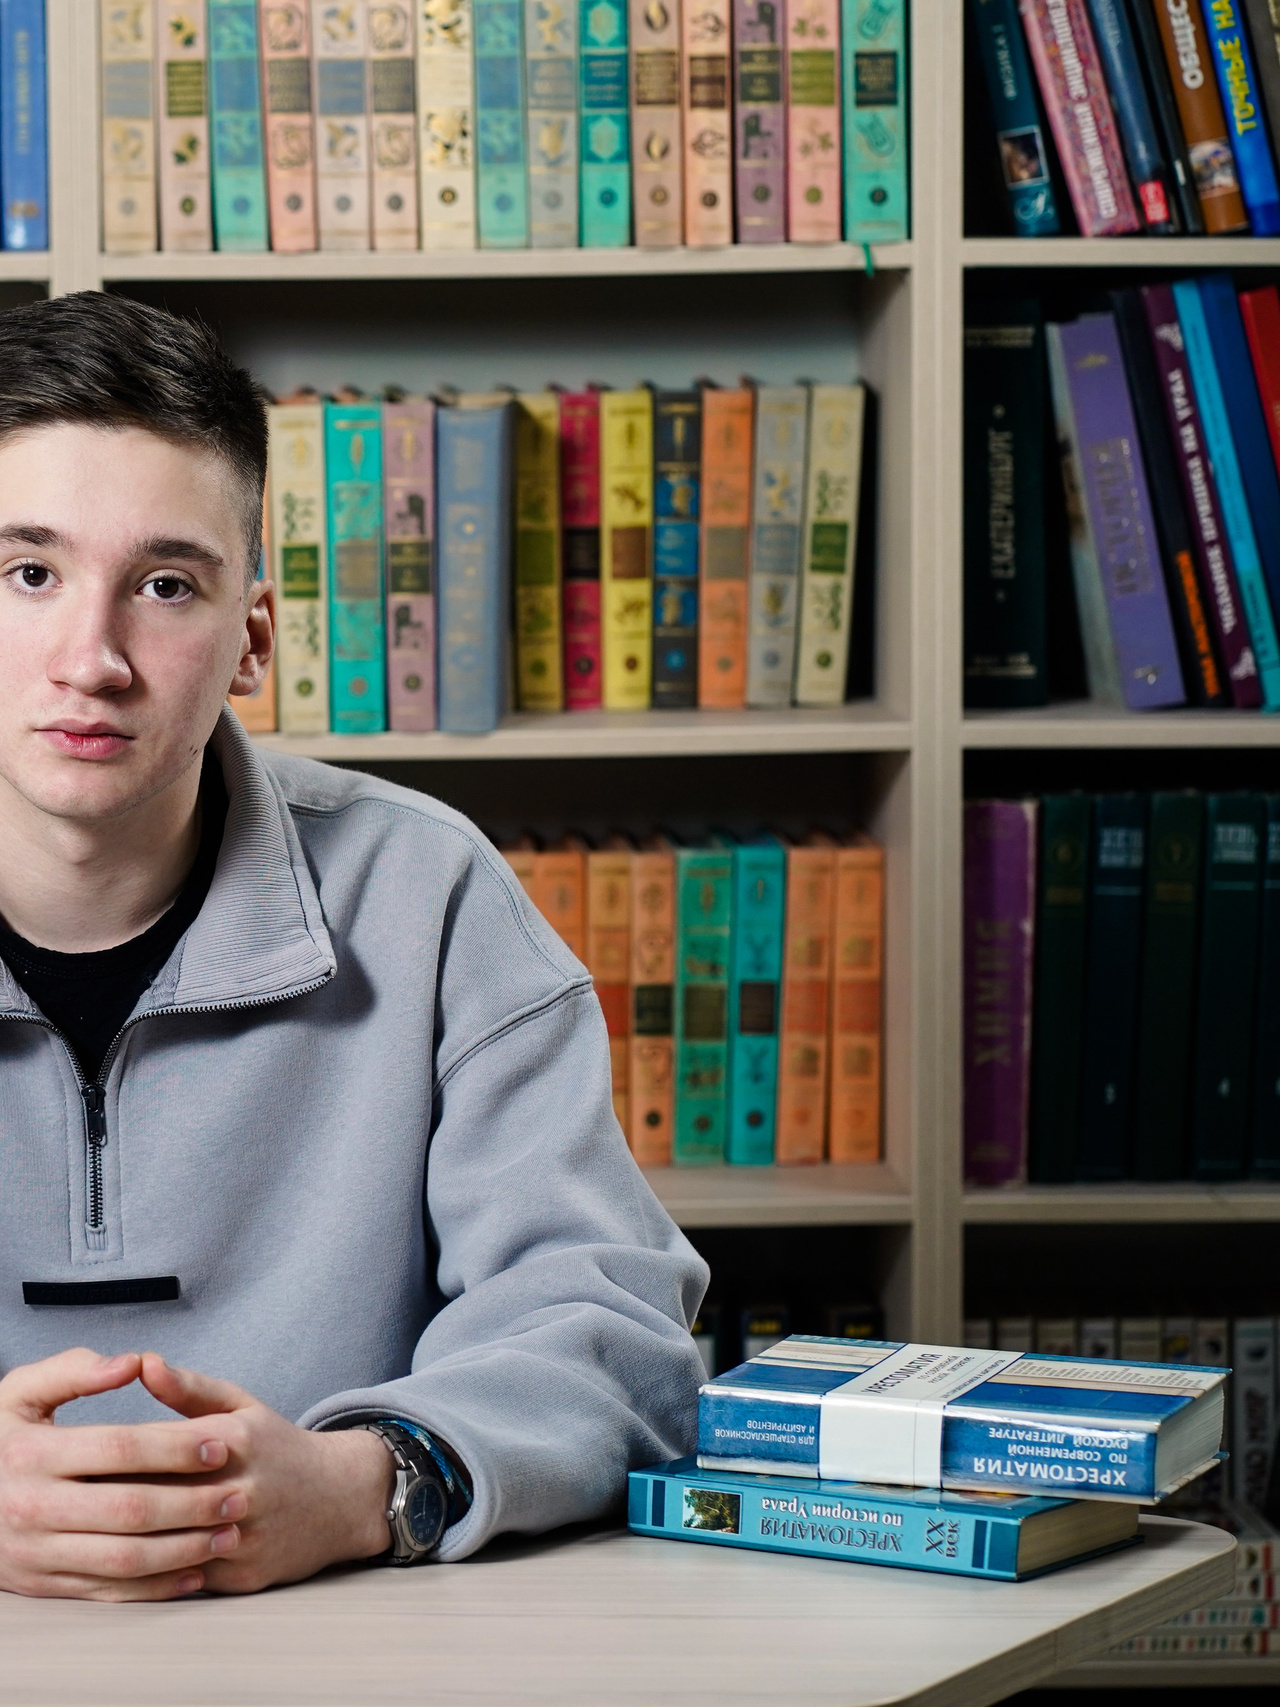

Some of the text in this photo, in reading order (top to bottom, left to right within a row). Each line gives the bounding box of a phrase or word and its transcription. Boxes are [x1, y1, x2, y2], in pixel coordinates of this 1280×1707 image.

[1218, 36, 1258, 137] ТОЧНЫЕ
[861, 1353, 943, 1394] ХРЕСТОМАТИЯ
[714, 1428, 815, 1446] ДЛЯ СТАРШЕКЛАССНИКОВ
[746, 1420, 815, 1433] И АБИТУРИЕНТОВ
[988, 1427, 1129, 1450] РУССКОЙ ЛИТЕРАТУРЕ
[1007, 1444, 1127, 1464] ПО СОВРЕМЕННОЙ
[973, 1457, 1127, 1486] ХРЕСТОМАТИЯ
[761, 1496, 903, 1527] по истории Урала
[760, 1517, 903, 1552] ХРЕСТОМАТИЯ
